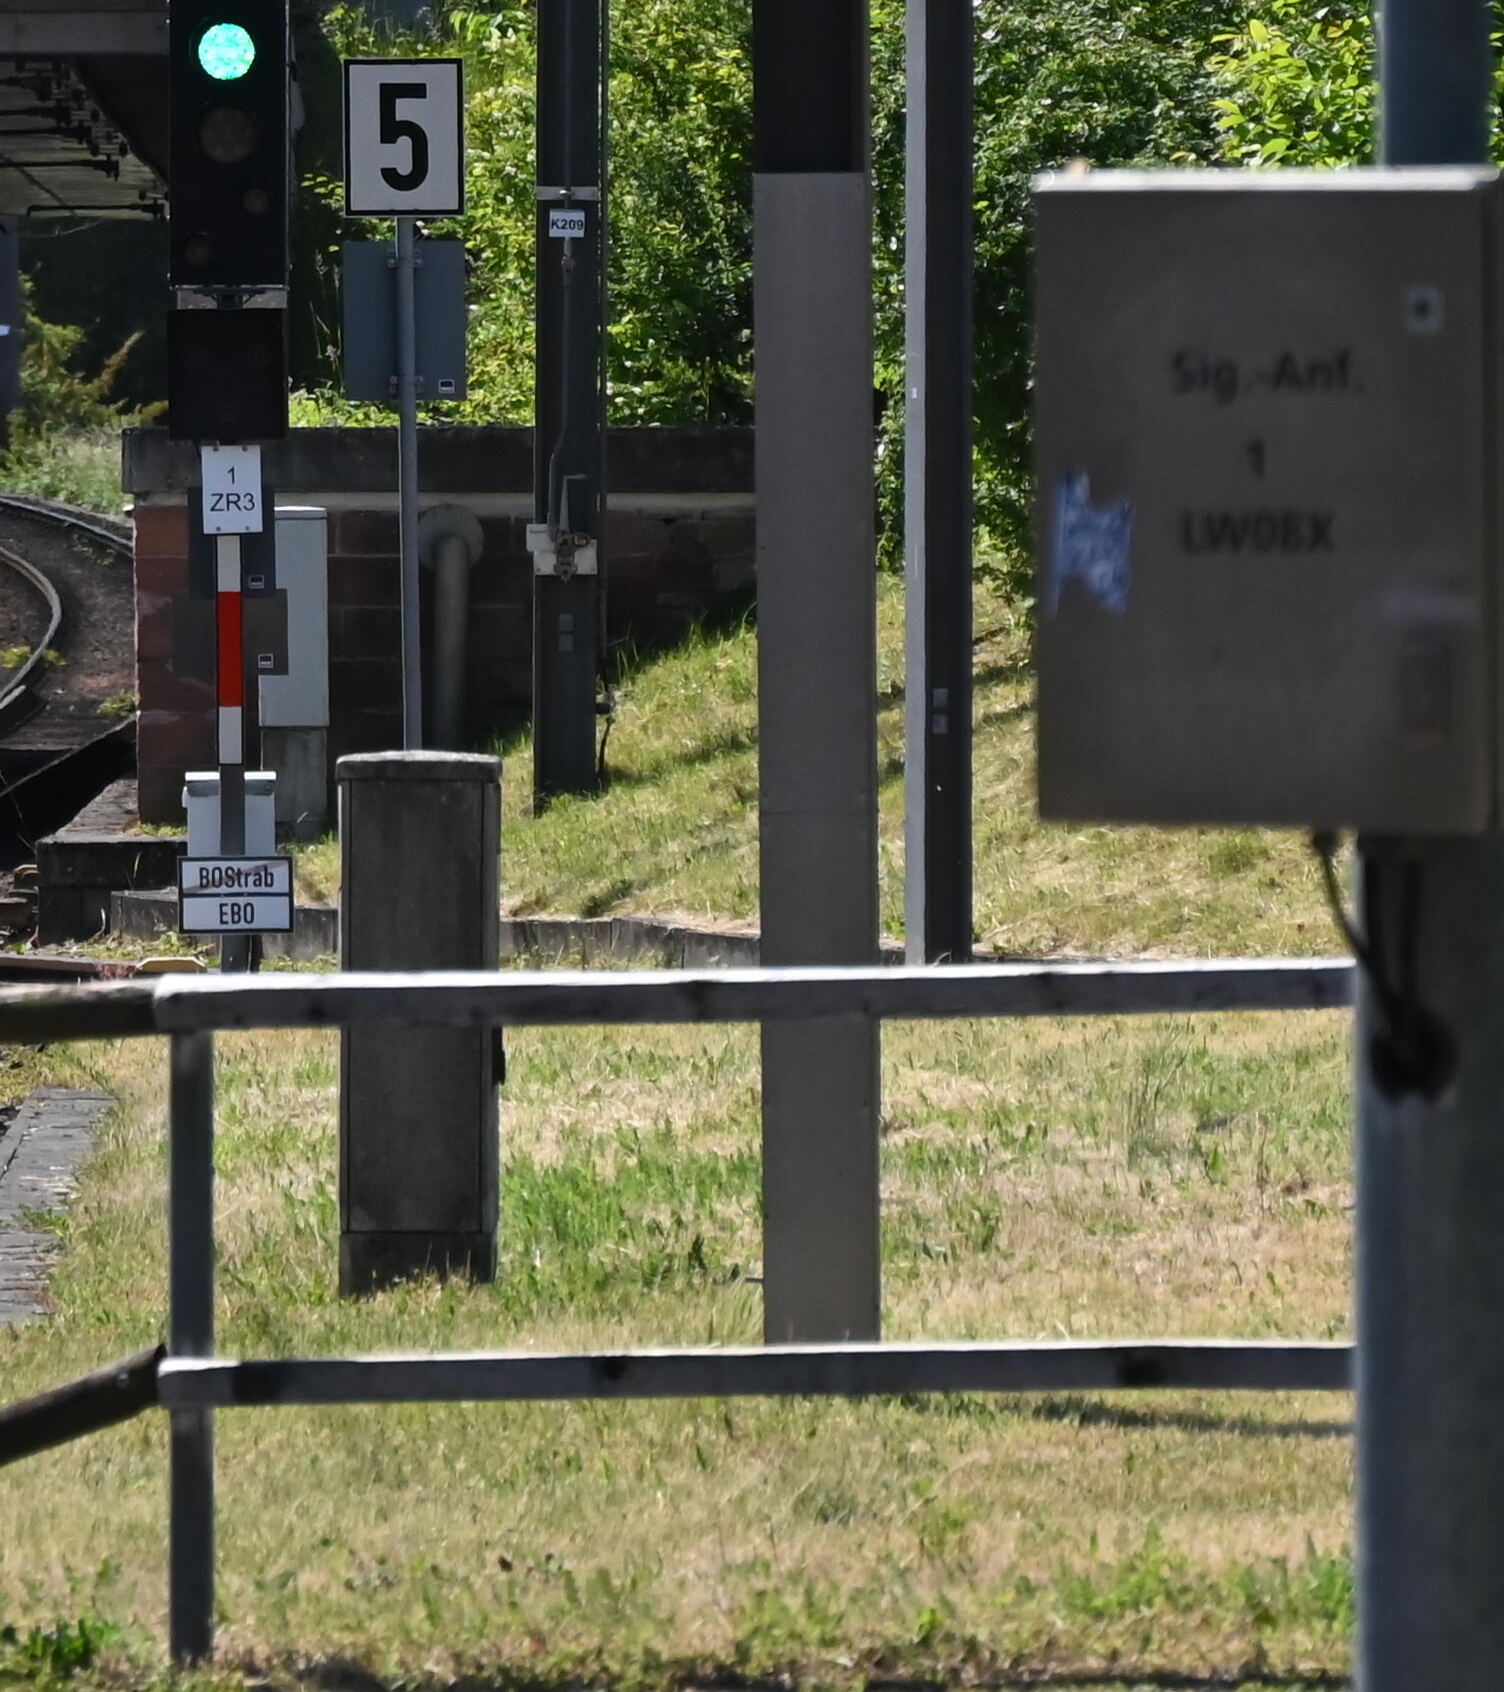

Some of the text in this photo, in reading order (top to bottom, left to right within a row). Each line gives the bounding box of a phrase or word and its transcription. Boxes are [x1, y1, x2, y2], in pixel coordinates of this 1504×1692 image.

[379, 83, 428, 191] 5
[551, 218, 584, 230] K209
[1247, 438, 1266, 480] 1
[227, 466, 235, 485] 1
[210, 492, 255, 512] ZR3
[199, 864, 274, 888] BOStrab
[219, 902, 255, 925] EBO
